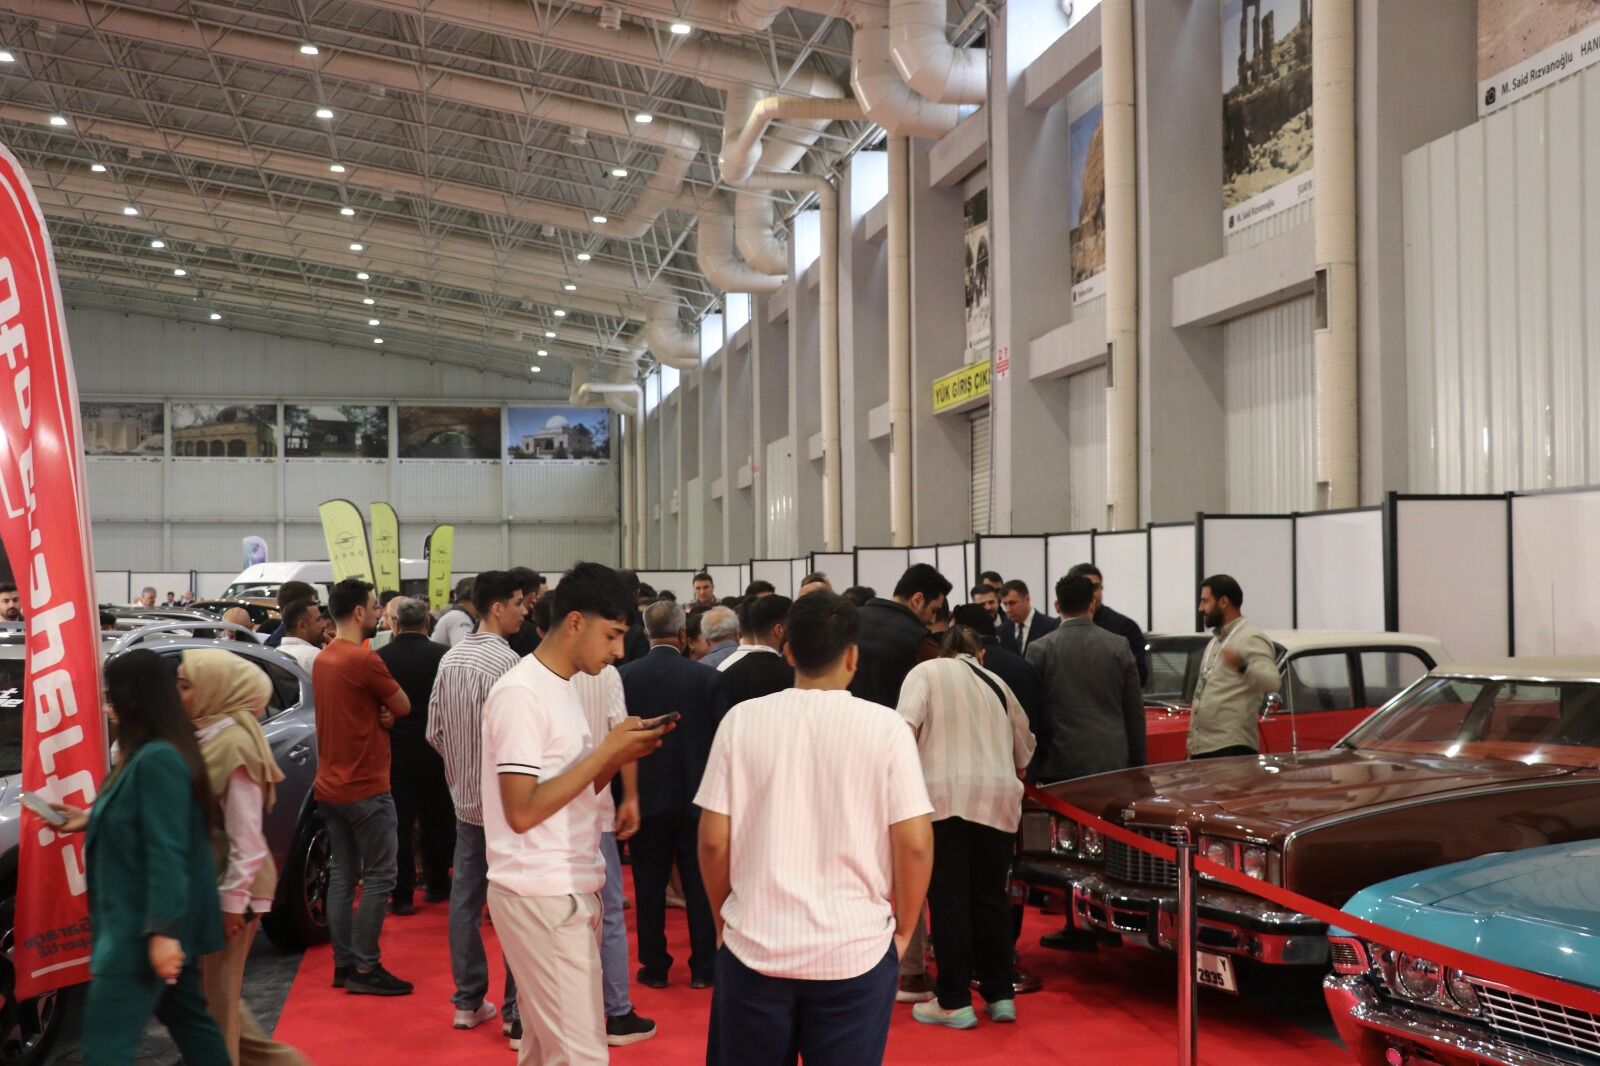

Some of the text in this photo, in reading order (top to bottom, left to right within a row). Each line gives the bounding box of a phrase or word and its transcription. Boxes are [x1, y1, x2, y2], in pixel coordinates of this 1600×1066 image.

[1501, 83, 1510, 95] M.
[1512, 72, 1529, 91] Said
[935, 383, 951, 405] YÜK
[1198, 968, 1224, 986] 2935
